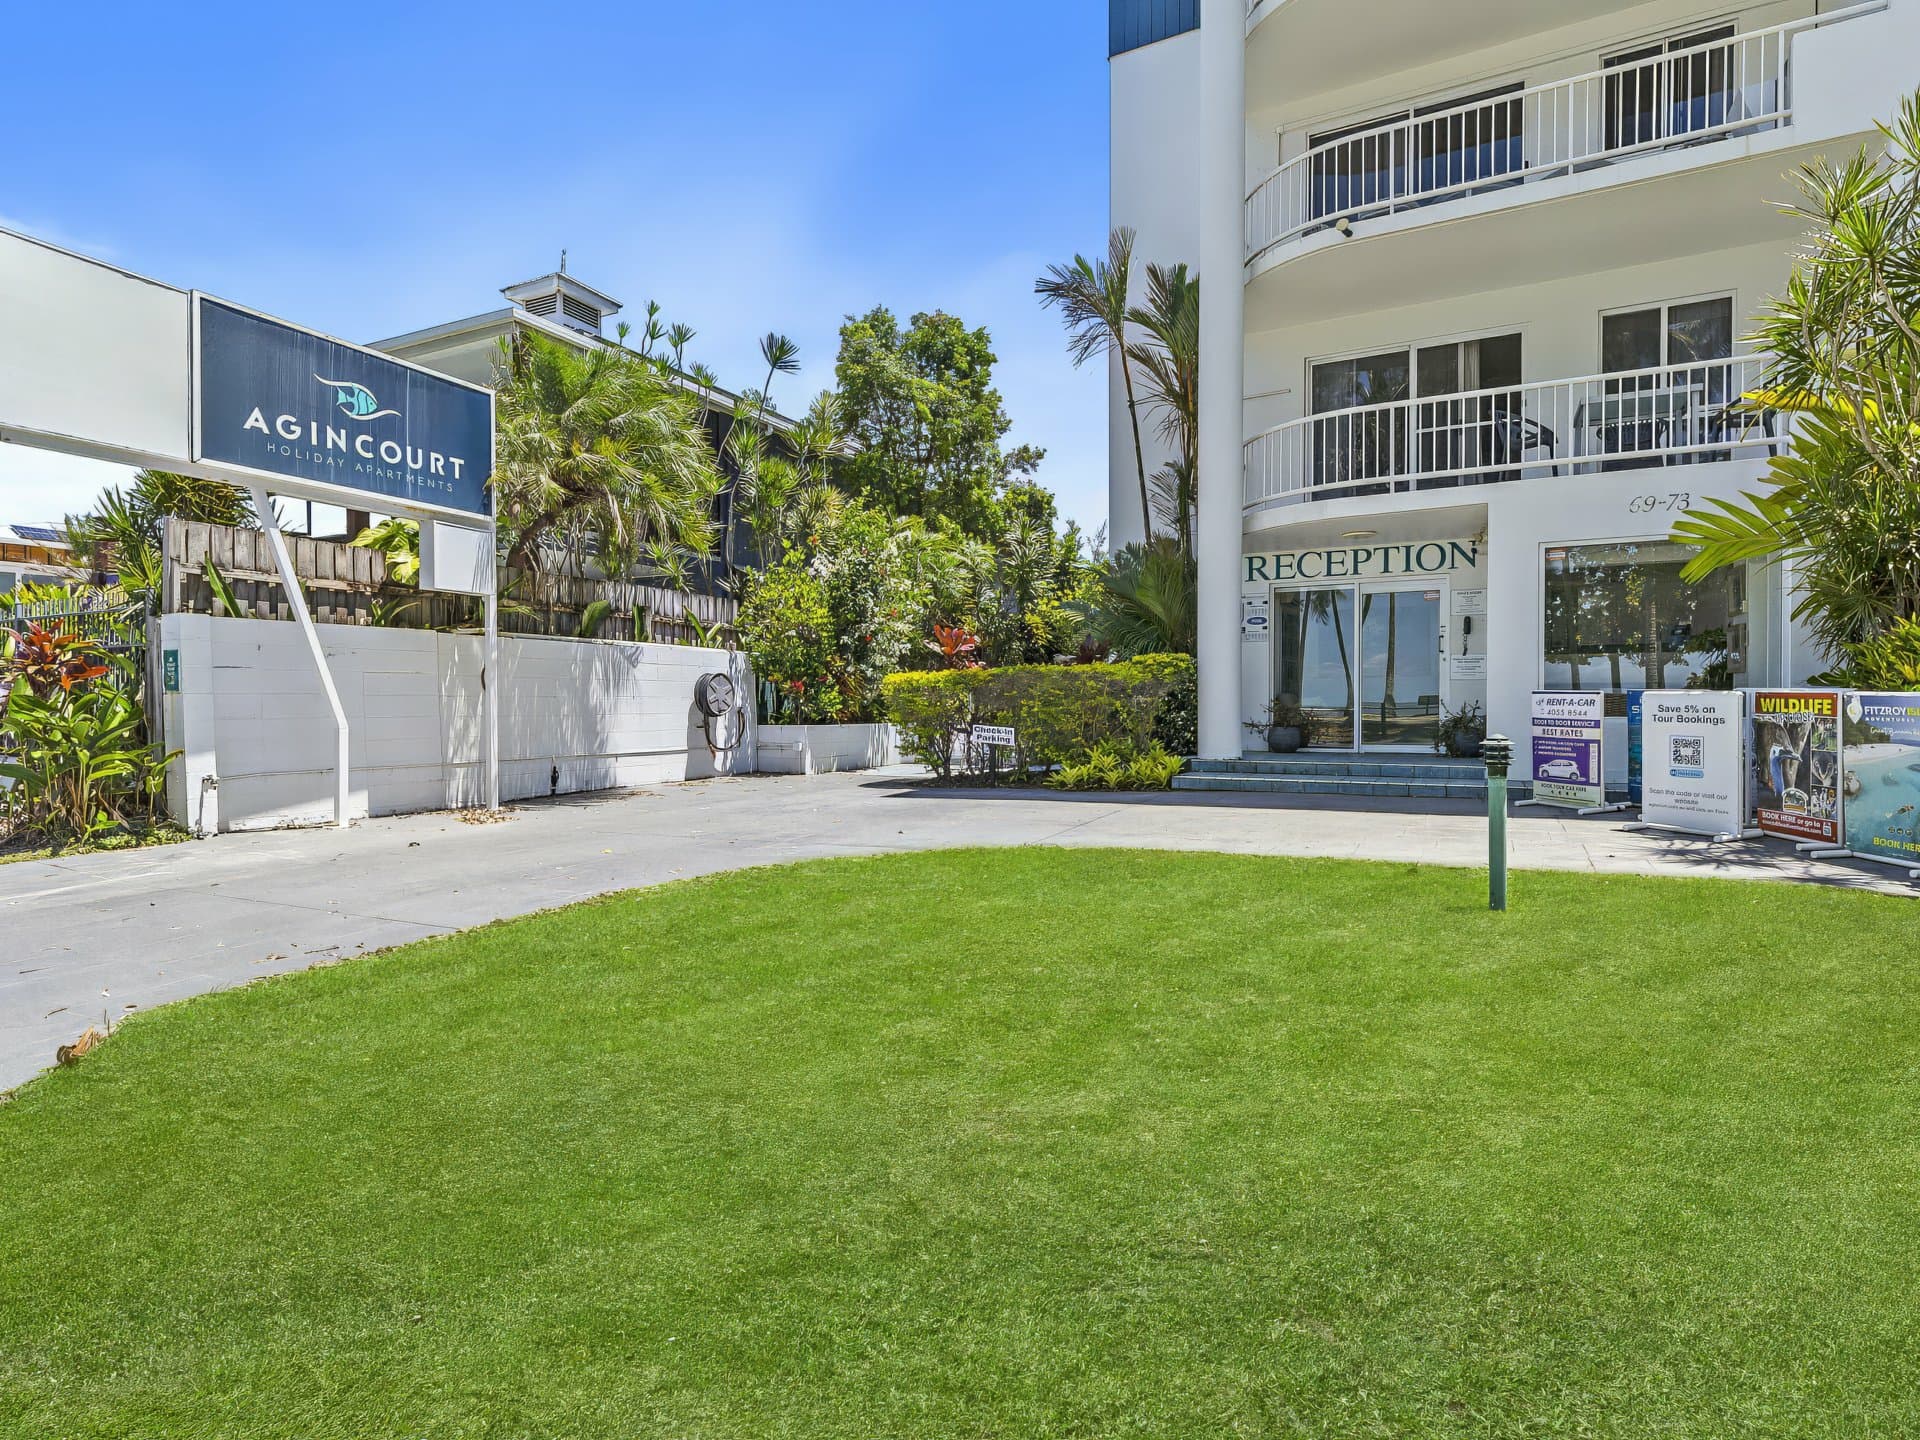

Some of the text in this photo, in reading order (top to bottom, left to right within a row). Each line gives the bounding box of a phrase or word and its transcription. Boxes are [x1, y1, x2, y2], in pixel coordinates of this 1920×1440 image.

[243, 407, 464, 479] AGINCOURT
[267, 442, 453, 492] HOLIDAY APARTMENTS
[1629, 493, 1690, 513] 69-73
[1245, 540, 1477, 582] RECEPTION
[1546, 698, 1596, 707] RENT-A-CAR
[1760, 698, 1832, 714] WILDLIFE
[1658, 705, 1681, 713] Save
[1684, 705, 1699, 713] 5%
[1864, 706, 1906, 716] FITZROY
[1652, 714, 1726, 725] Tour Bookings
[976, 734, 1011, 744] Parking
[1762, 811, 1780, 820] BOOK
[1781, 814, 1796, 823] HERE
[1873, 836, 1901, 849] BOOK
